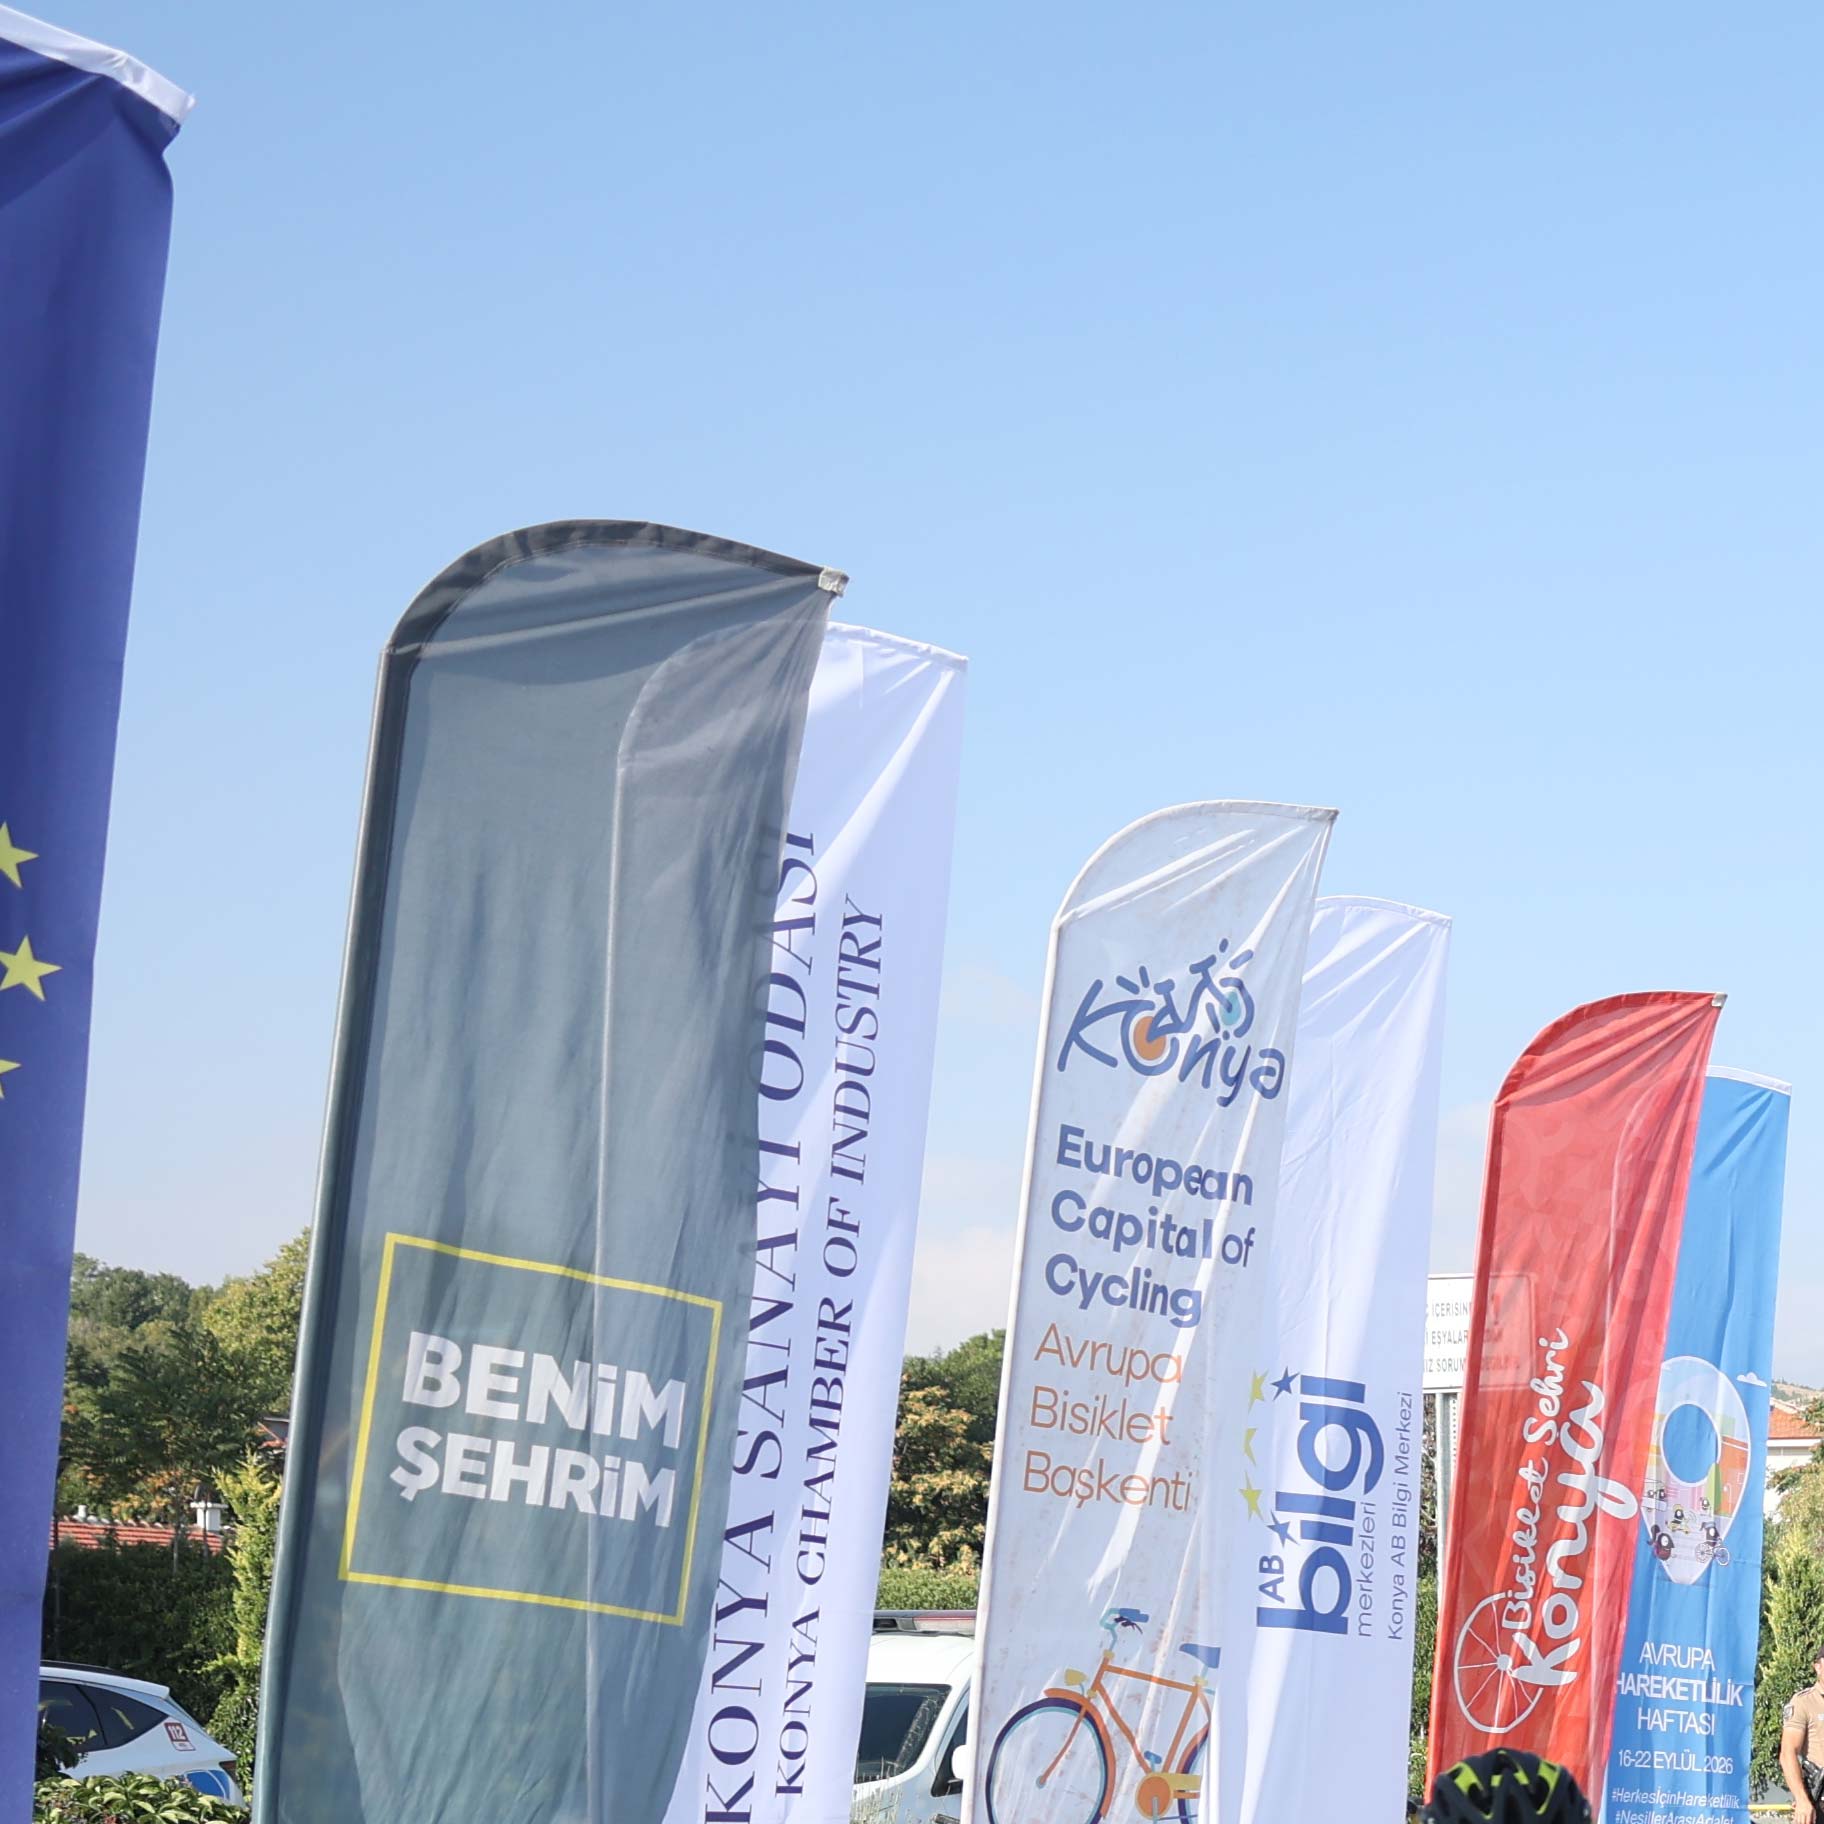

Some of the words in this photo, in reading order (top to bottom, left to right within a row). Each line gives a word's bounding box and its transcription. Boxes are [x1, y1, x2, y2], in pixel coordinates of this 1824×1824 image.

[830, 893, 883, 1185] INDUSTRY
[1057, 965, 1285, 1107] Konya
[1057, 1123, 1254, 1206] European
[823, 1196, 864, 1279] OF
[1051, 1189, 1214, 1259] Capital
[1221, 1227, 1256, 1268] of
[1045, 1253, 1203, 1329] Cycling
[1034, 1323, 1183, 1384] Avrupa
[1523, 1327, 1568, 1446] Şehri
[795, 1297, 854, 1587] CHAMBER
[1030, 1386, 1174, 1446] Bisiklet
[1394, 1391, 1413, 1477] Merkezi
[1023, 1450, 1192, 1513] Başkenti
[1256, 1374, 1385, 1635] bilgi
[1392, 1481, 1412, 1528] Bilgi
[1258, 1554, 1285, 1603] AB
[1358, 1501, 1377, 1637] merkezleri
[1390, 1535, 1406, 1568] AB
[1502, 1454, 1549, 1630] Bisiklet
[1389, 1574, 1409, 1640] Konya
[1639, 1641, 1716, 1671] AVRUPA
[775, 1608, 821, 1798] KONYA
[1637, 1707, 1716, 1736] HAFTASI
[1618, 1749, 1651, 1768] 16-22
[1652, 1747, 1703, 1773] EYLÜL
